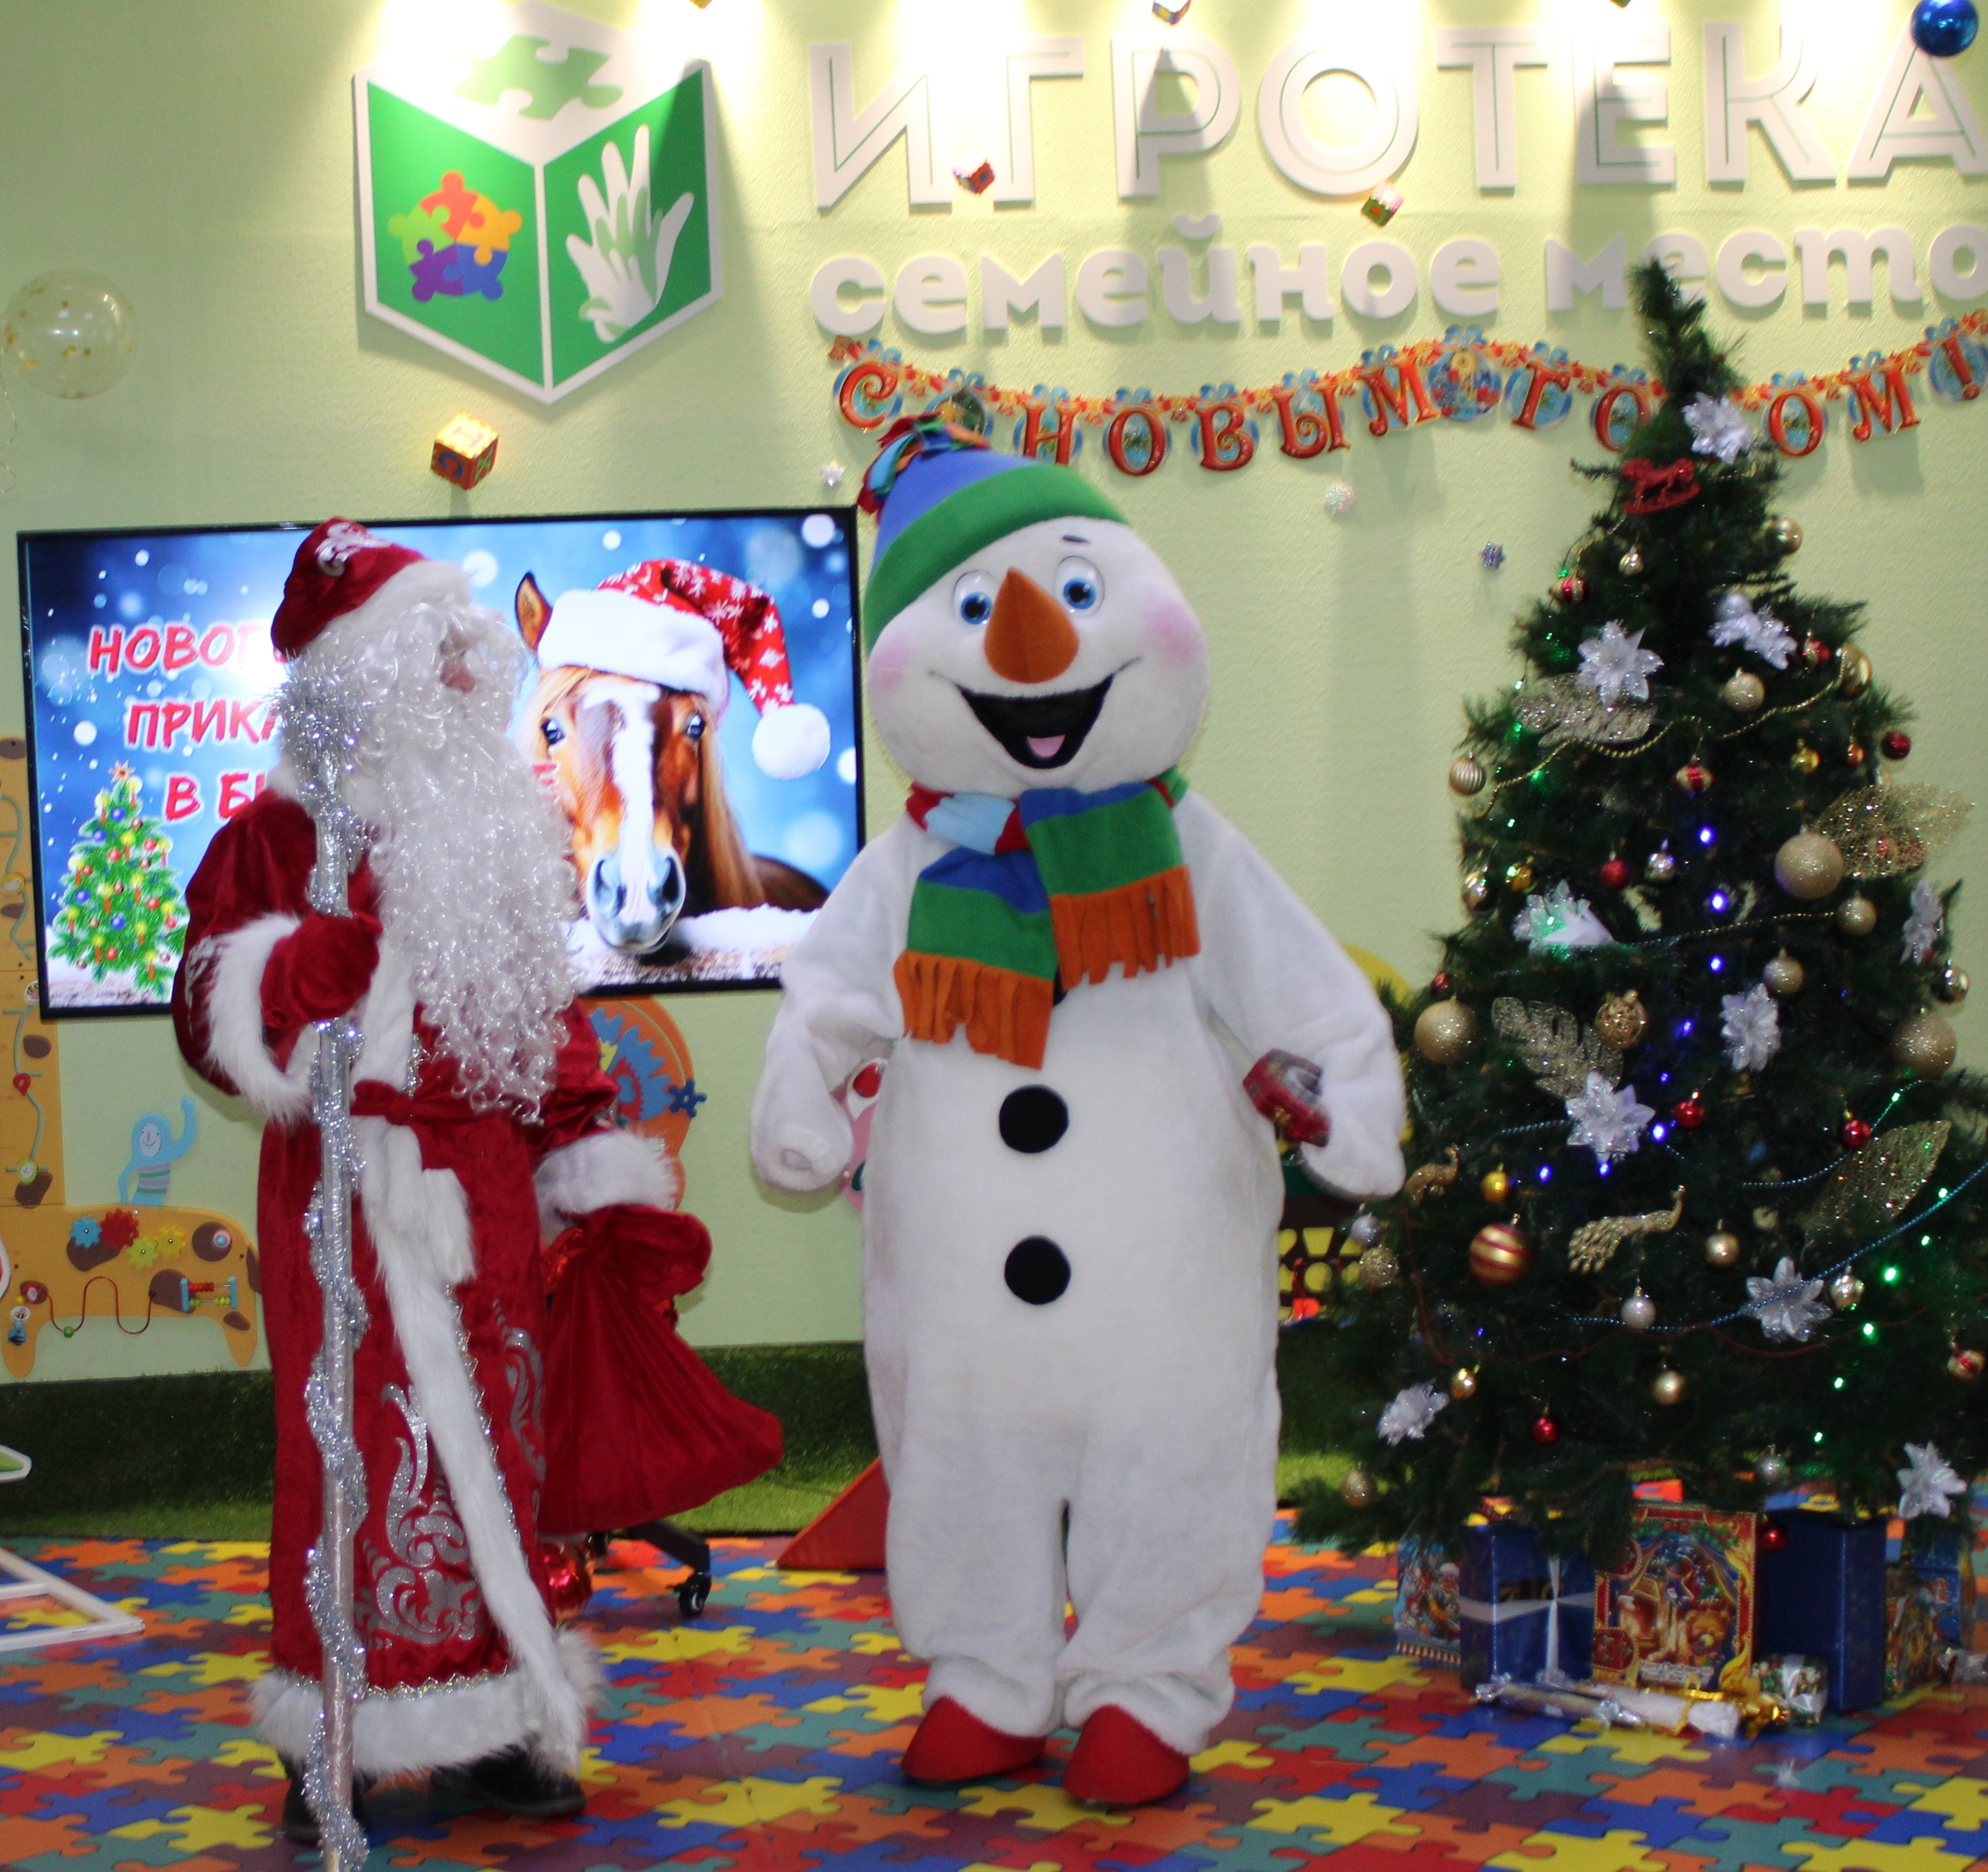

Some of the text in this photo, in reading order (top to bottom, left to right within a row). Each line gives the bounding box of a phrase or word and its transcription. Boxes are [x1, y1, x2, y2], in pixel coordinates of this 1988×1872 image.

[809, 14, 1988, 208] ИГРОТЕКА
[809, 214, 1500, 335] семейное
[1019, 355, 1441, 476] НОВЫМ
[1511, 336, 1981, 458] ГООМ!
[165, 775, 200, 822] В
